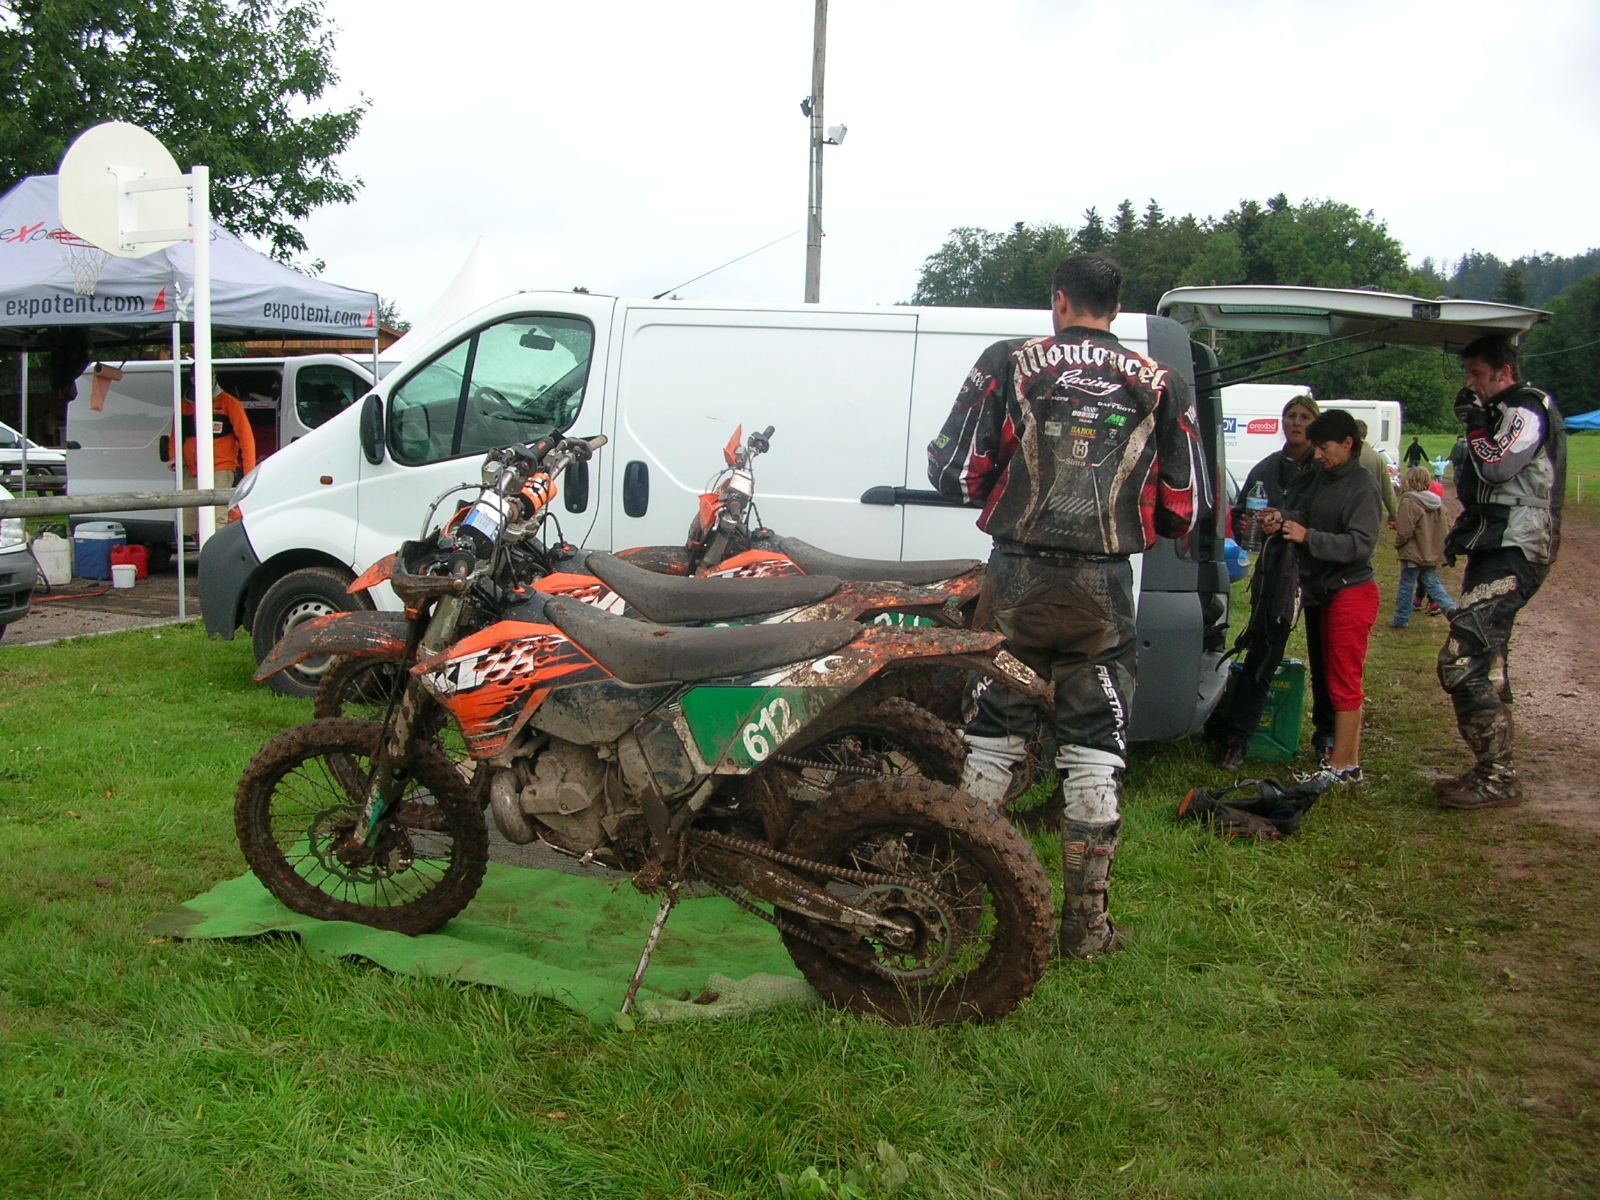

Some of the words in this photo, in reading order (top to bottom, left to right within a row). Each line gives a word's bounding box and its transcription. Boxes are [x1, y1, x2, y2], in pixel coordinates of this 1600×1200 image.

[6, 294, 145, 318] expotent.com
[263, 302, 361, 327] expotent.com
[1055, 369, 1122, 395] Racing
[742, 697, 801, 762] 612
